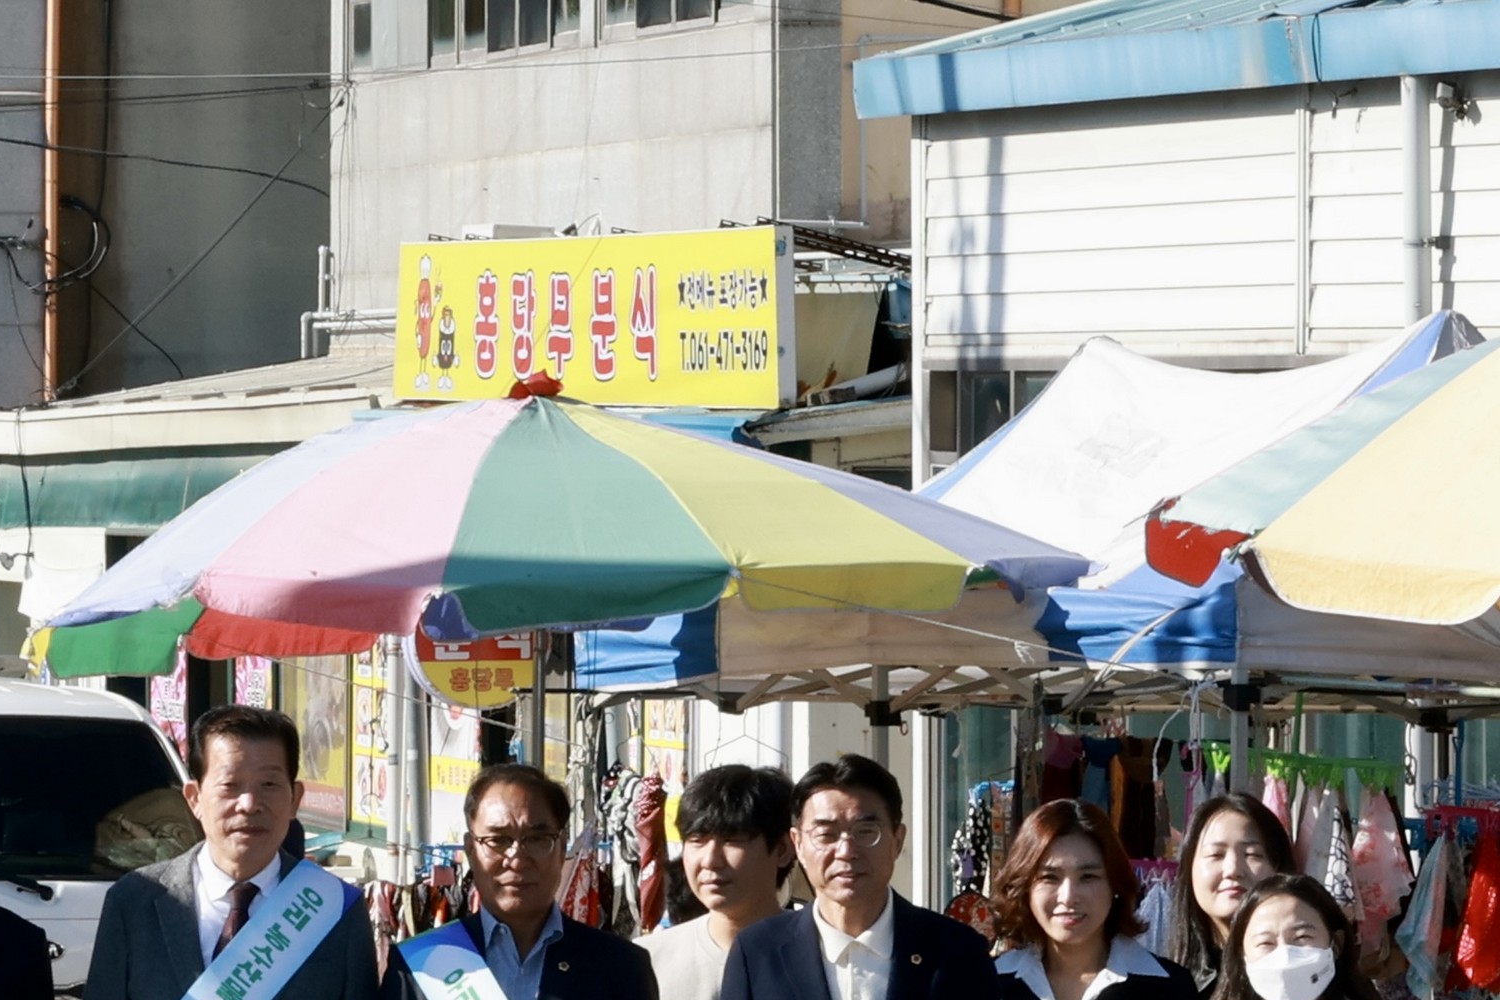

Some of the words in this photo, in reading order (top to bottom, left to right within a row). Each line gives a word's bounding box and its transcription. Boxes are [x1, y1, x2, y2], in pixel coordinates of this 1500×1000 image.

[687, 270, 715, 310] 전메뉴
[719, 269, 758, 309] 포장가능
[474, 267, 573, 380] 홍당무
[589, 263, 657, 382] 분식
[679, 330, 768, 370] T.061-471-3169
[449, 667, 515, 692] 홍당무
[282, 886, 324, 932] 우리
